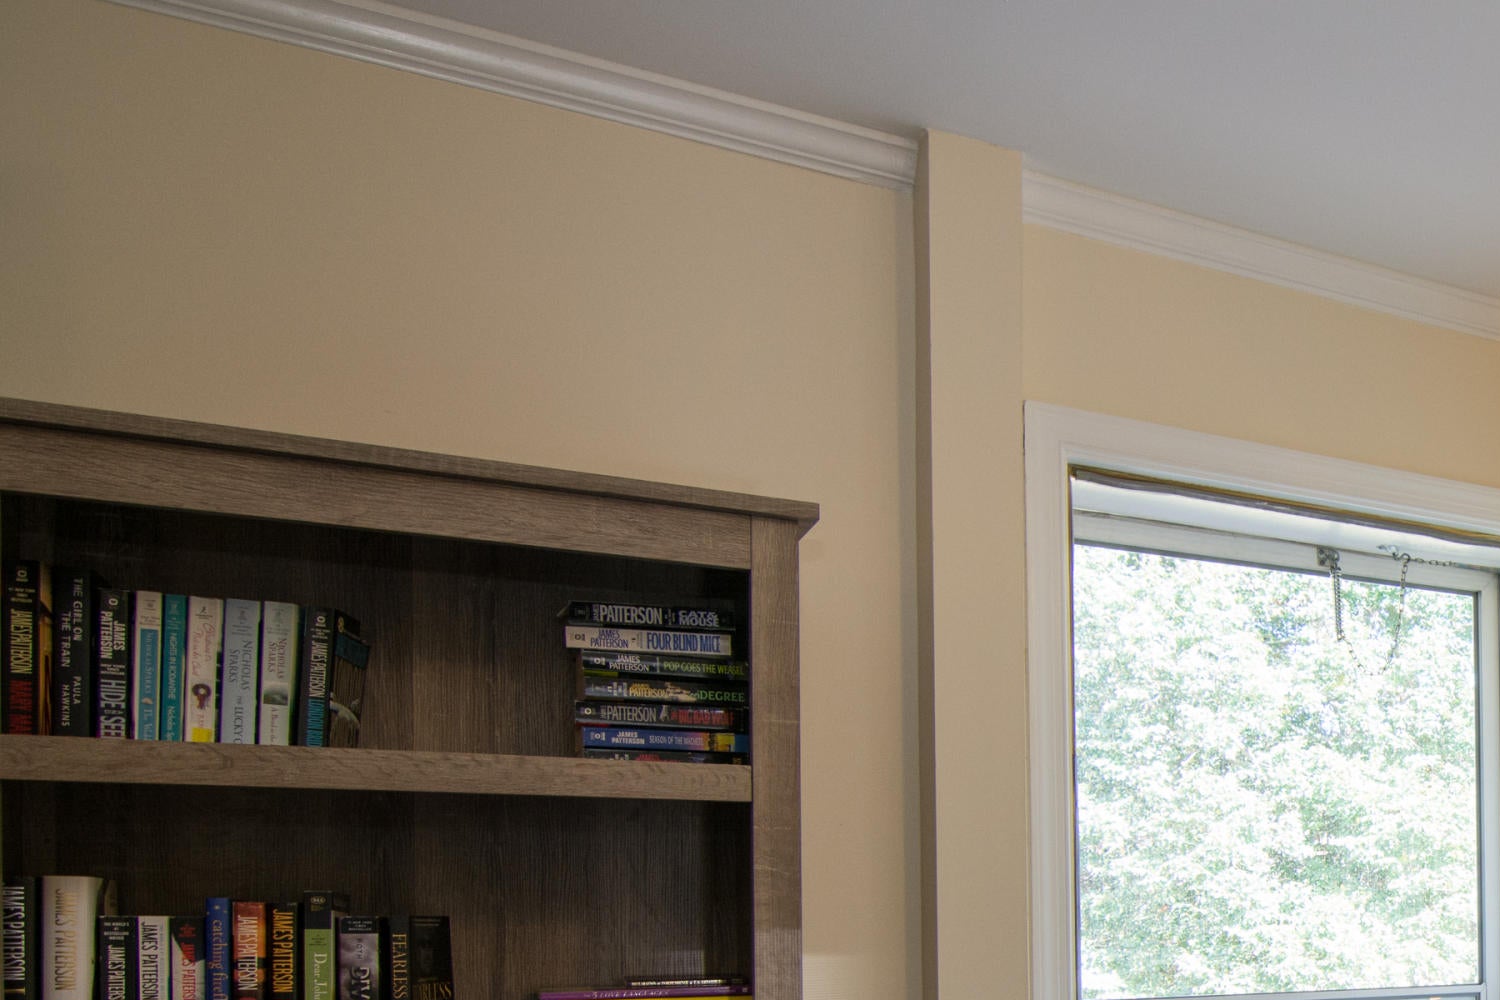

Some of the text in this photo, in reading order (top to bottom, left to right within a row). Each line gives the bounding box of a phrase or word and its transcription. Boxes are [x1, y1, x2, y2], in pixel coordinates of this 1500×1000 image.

[72, 600, 83, 624] GIRL
[600, 605, 663, 624] PATTERSON
[679, 617, 720, 628] MOUSE
[10, 609, 33, 674] JAMES PATTERSON
[60, 611, 72, 668] THE TRAIN
[73, 627, 83, 641] ON
[100, 610, 114, 660] PATTERSON
[113, 620, 126, 652] JAMES
[590, 637, 629, 649] PATTERSON
[598, 629, 621, 640] JAMES
[647, 632, 721, 653] FOUR BLIND MICE
[229, 648, 241, 684] SPARKS
[241, 640, 253, 691] NICHOLAS
[277, 637, 288, 679] NICHOLAS
[309, 640, 328, 698] JAMES PATTERSON
[608, 661, 650, 672] PATTERSON
[617, 652, 641, 664] JAMES
[663, 661, 681, 671] POP
[702, 663, 717, 673] THE
[72, 675, 82, 705] PAULA
[100, 679, 126, 709] HIDE
[701, 690, 745, 702] DEGREE
[60, 684, 71, 728] HAWKINS
[233, 706, 244, 736] LUCKY
[307, 698, 325, 729] LONDON
[607, 705, 657, 722] PATTERSON
[4, 885, 26, 982] JAMES PATTERSON
[54, 888, 77, 992] JAMES PATTERSON
[141, 921, 157, 951] JAMES
[208, 919, 229, 970] catching
[107, 944, 126, 969] JAMES
[181, 941, 196, 967] JAMES
[237, 915, 258, 991] JAMES PATTERSON
[271, 909, 295, 993] JAMES PATTERSON
[312, 953, 328, 977] Dear
[391, 932, 409, 1000] FEARLESS
